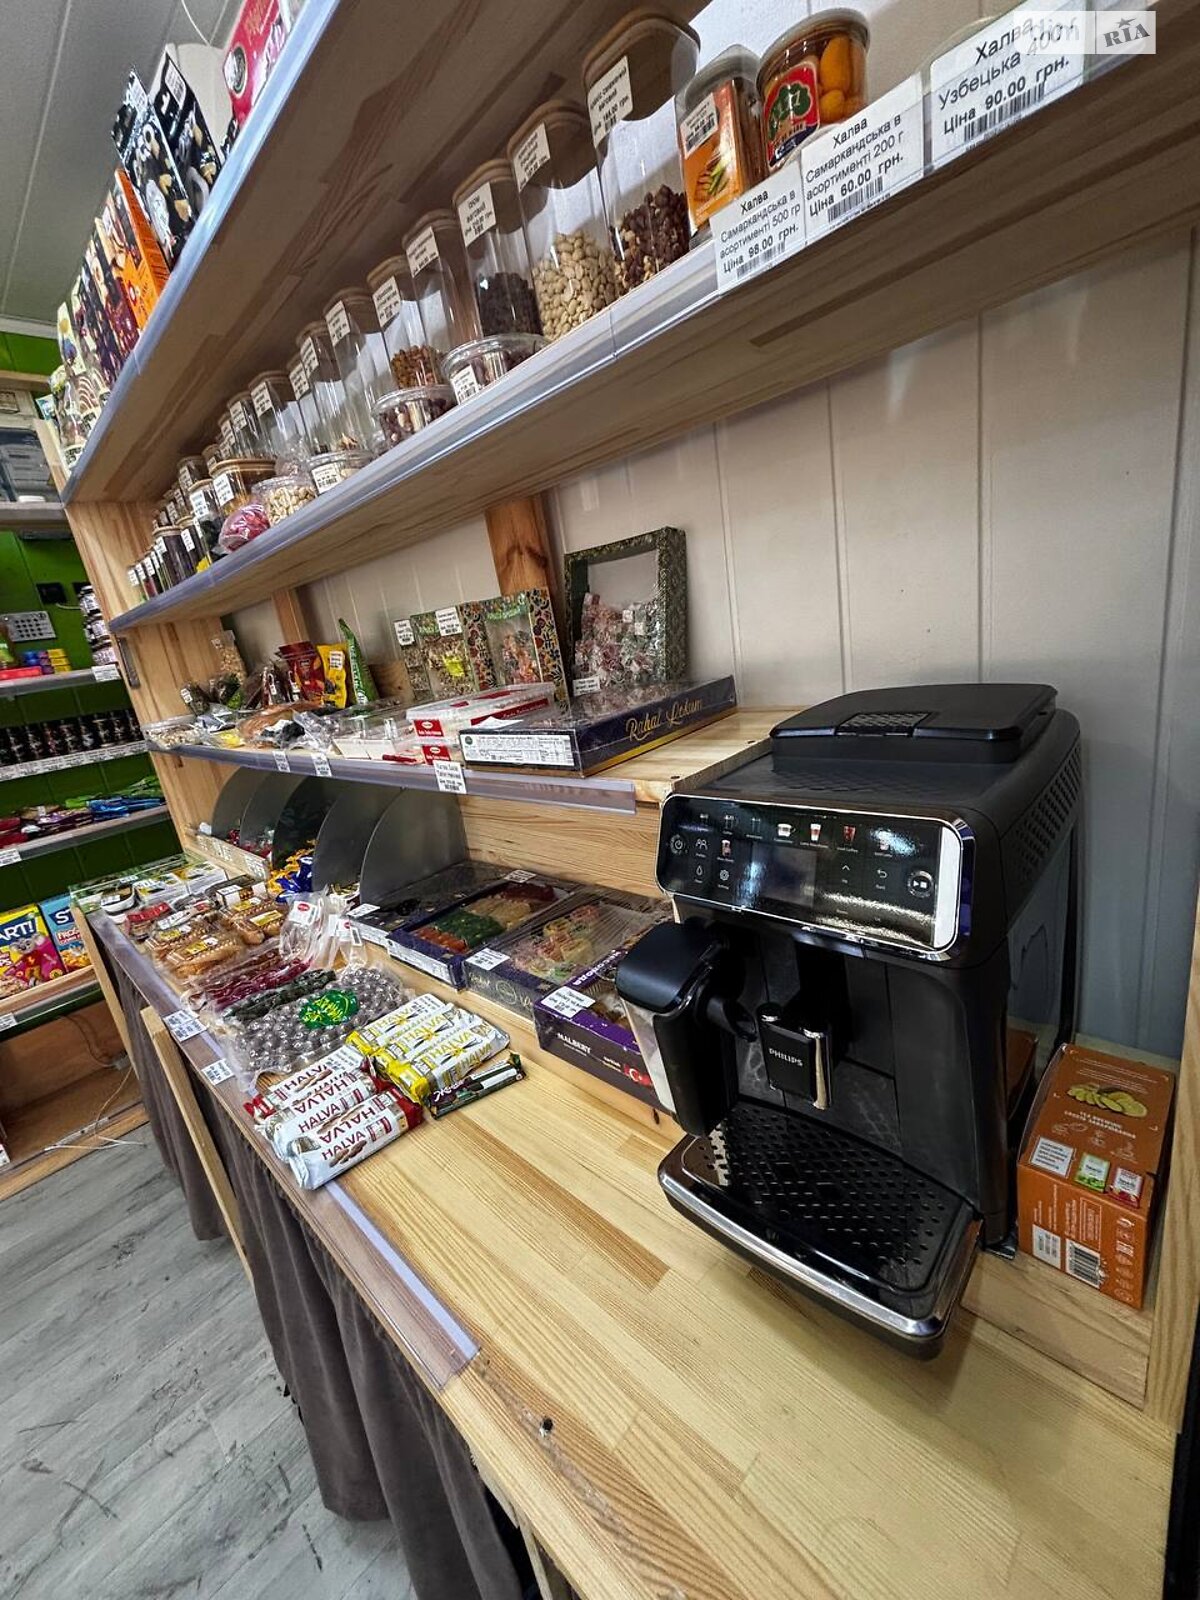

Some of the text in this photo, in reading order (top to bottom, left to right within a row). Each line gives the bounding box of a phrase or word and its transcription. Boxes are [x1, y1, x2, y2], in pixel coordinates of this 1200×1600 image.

[975, 17, 1033, 65] Халва
[939, 52, 1021, 110] Узбецька
[944, 55, 1069, 135] Ціна 90.00 грн.
[806, 120, 891, 183] Самаркандська
[894, 114, 901, 126] в
[833, 118, 867, 149] Халва
[807, 131, 904, 200] асортименті 200 г
[809, 153, 903, 217] Ціна 60.00 грн.
[720, 190, 796, 243] Самаркандська в
[740, 190, 768, 215] Халва
[720, 204, 800, 259] асортименті 500 гр
[723, 224, 799, 273] Ціна 98.00 грн.
[428, 1030, 472, 1062] HALVA
[769, 1047, 803, 1066] PHILIPS
[294, 1079, 348, 1114] HALVA
[298, 1102, 341, 1134] HALVA
[319, 1106, 376, 1144] HALVA
[321, 1130, 366, 1161] HALVA
